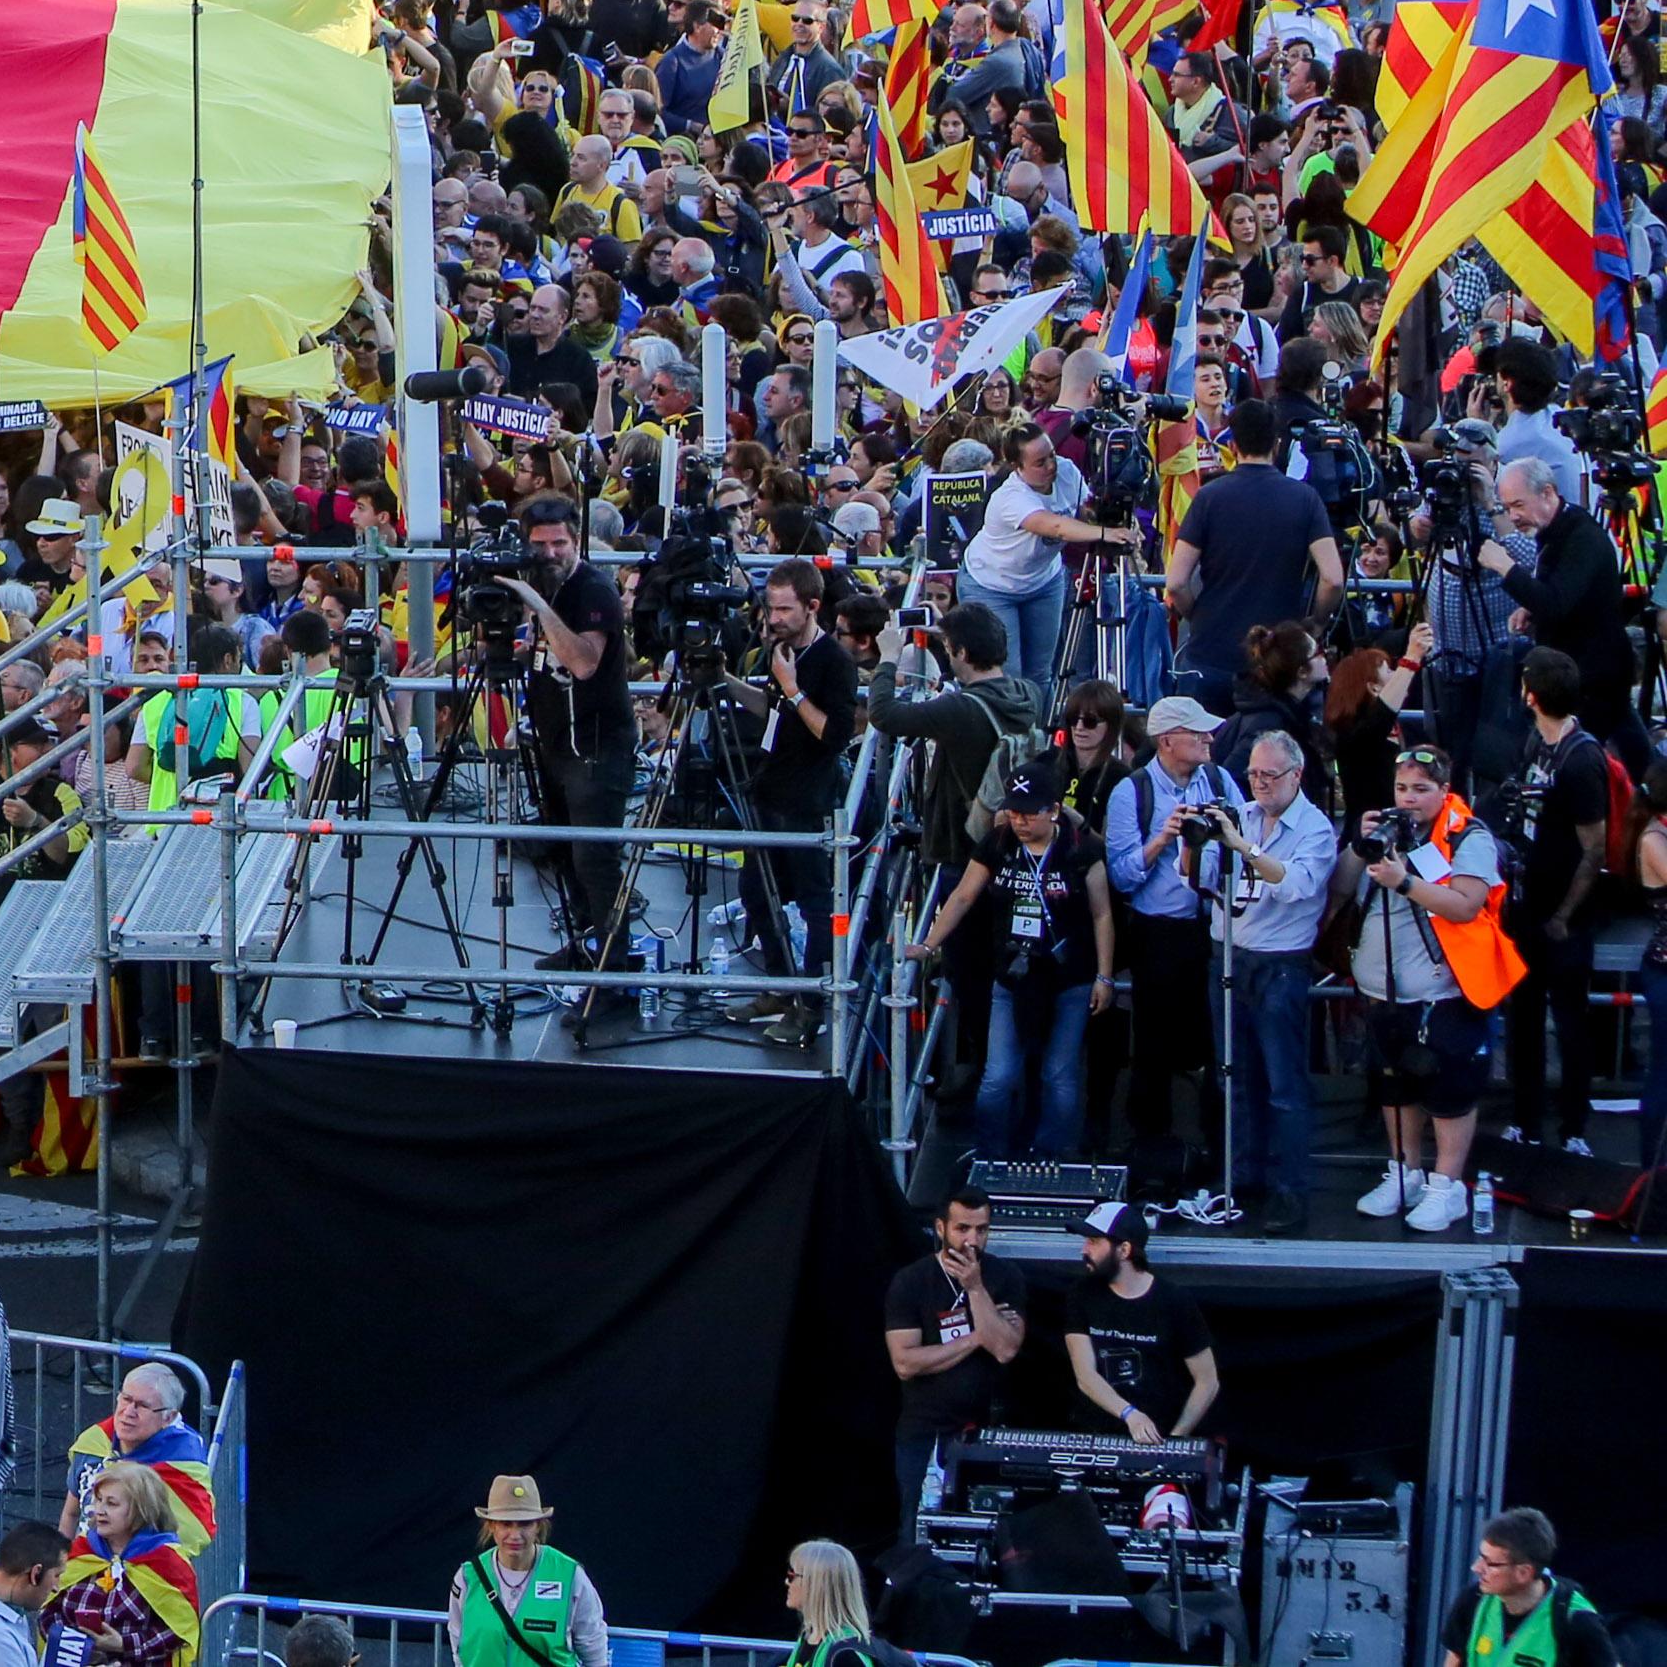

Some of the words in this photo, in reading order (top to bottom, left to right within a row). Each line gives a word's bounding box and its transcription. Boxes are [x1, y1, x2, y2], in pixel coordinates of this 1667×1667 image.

[928, 212, 994, 237] JUSTÍCIA
[3, 411, 45, 429] DELICTE
[326, 407, 345, 426] NO
[348, 409, 377, 429] HAY
[474, 399, 495, 422] HAY
[932, 477, 980, 491] REPÚBLICA
[1089, 1326, 1104, 1335] State
[1136, 1333, 1158, 1341] sound
